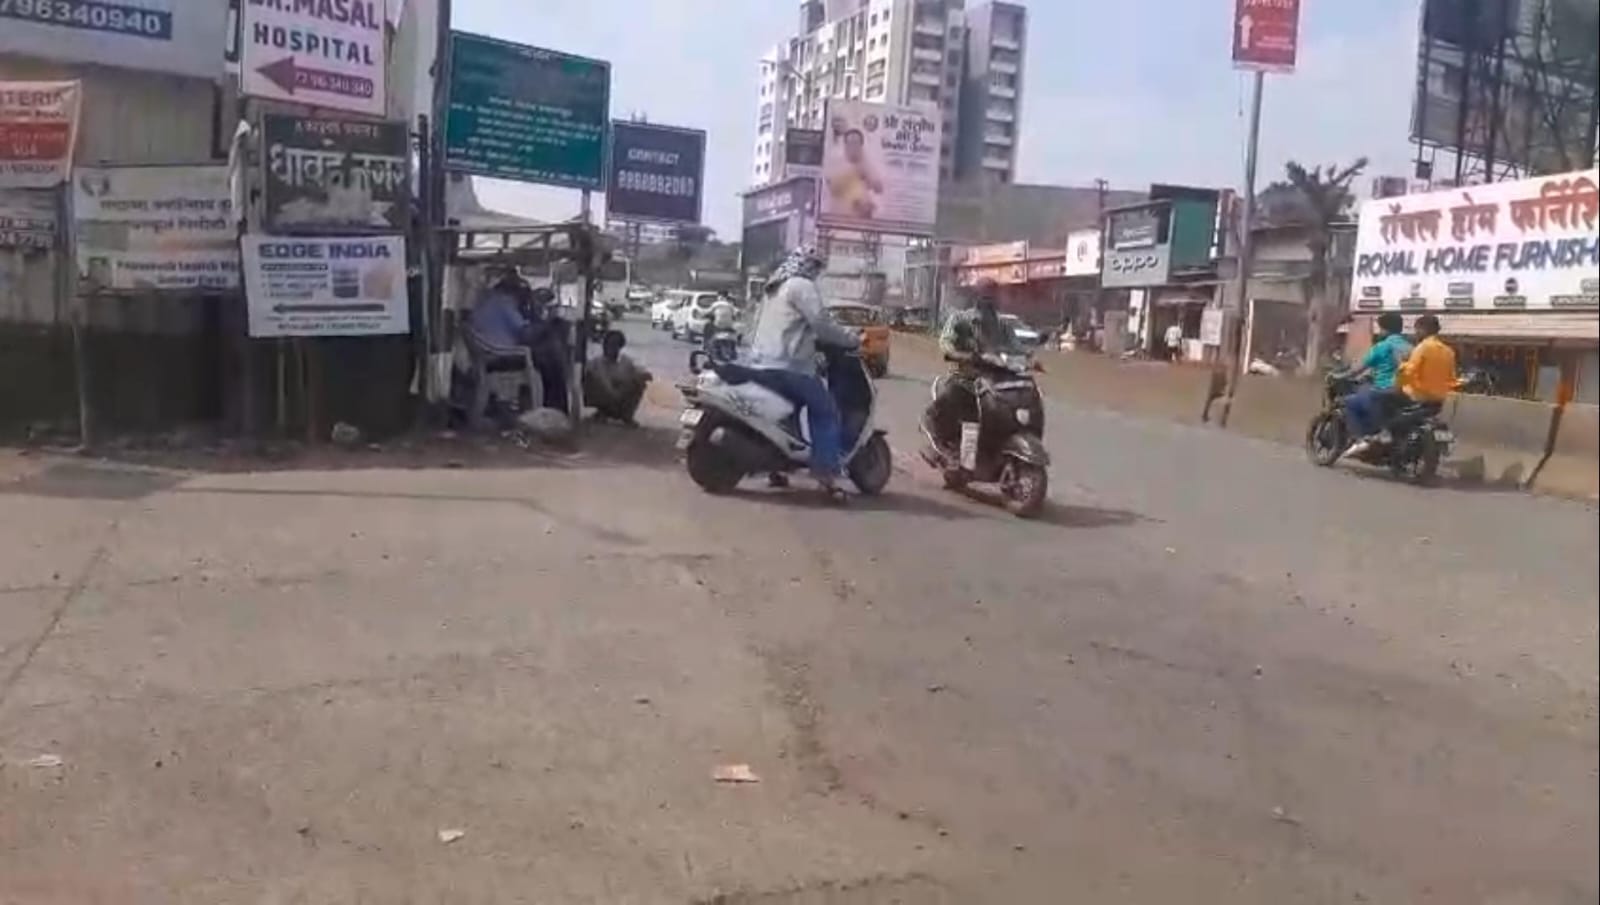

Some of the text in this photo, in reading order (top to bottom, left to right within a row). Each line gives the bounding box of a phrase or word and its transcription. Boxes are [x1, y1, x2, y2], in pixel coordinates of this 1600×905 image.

[253, 21, 375, 66] HOSPITAL
[628, 147, 679, 165] CONTACT
[1449, 191, 1499, 242] होम
[259, 243, 391, 259] EDGE INDIA
[1357, 250, 1418, 278] ROYAL
[1423, 244, 1490, 274] HOME
